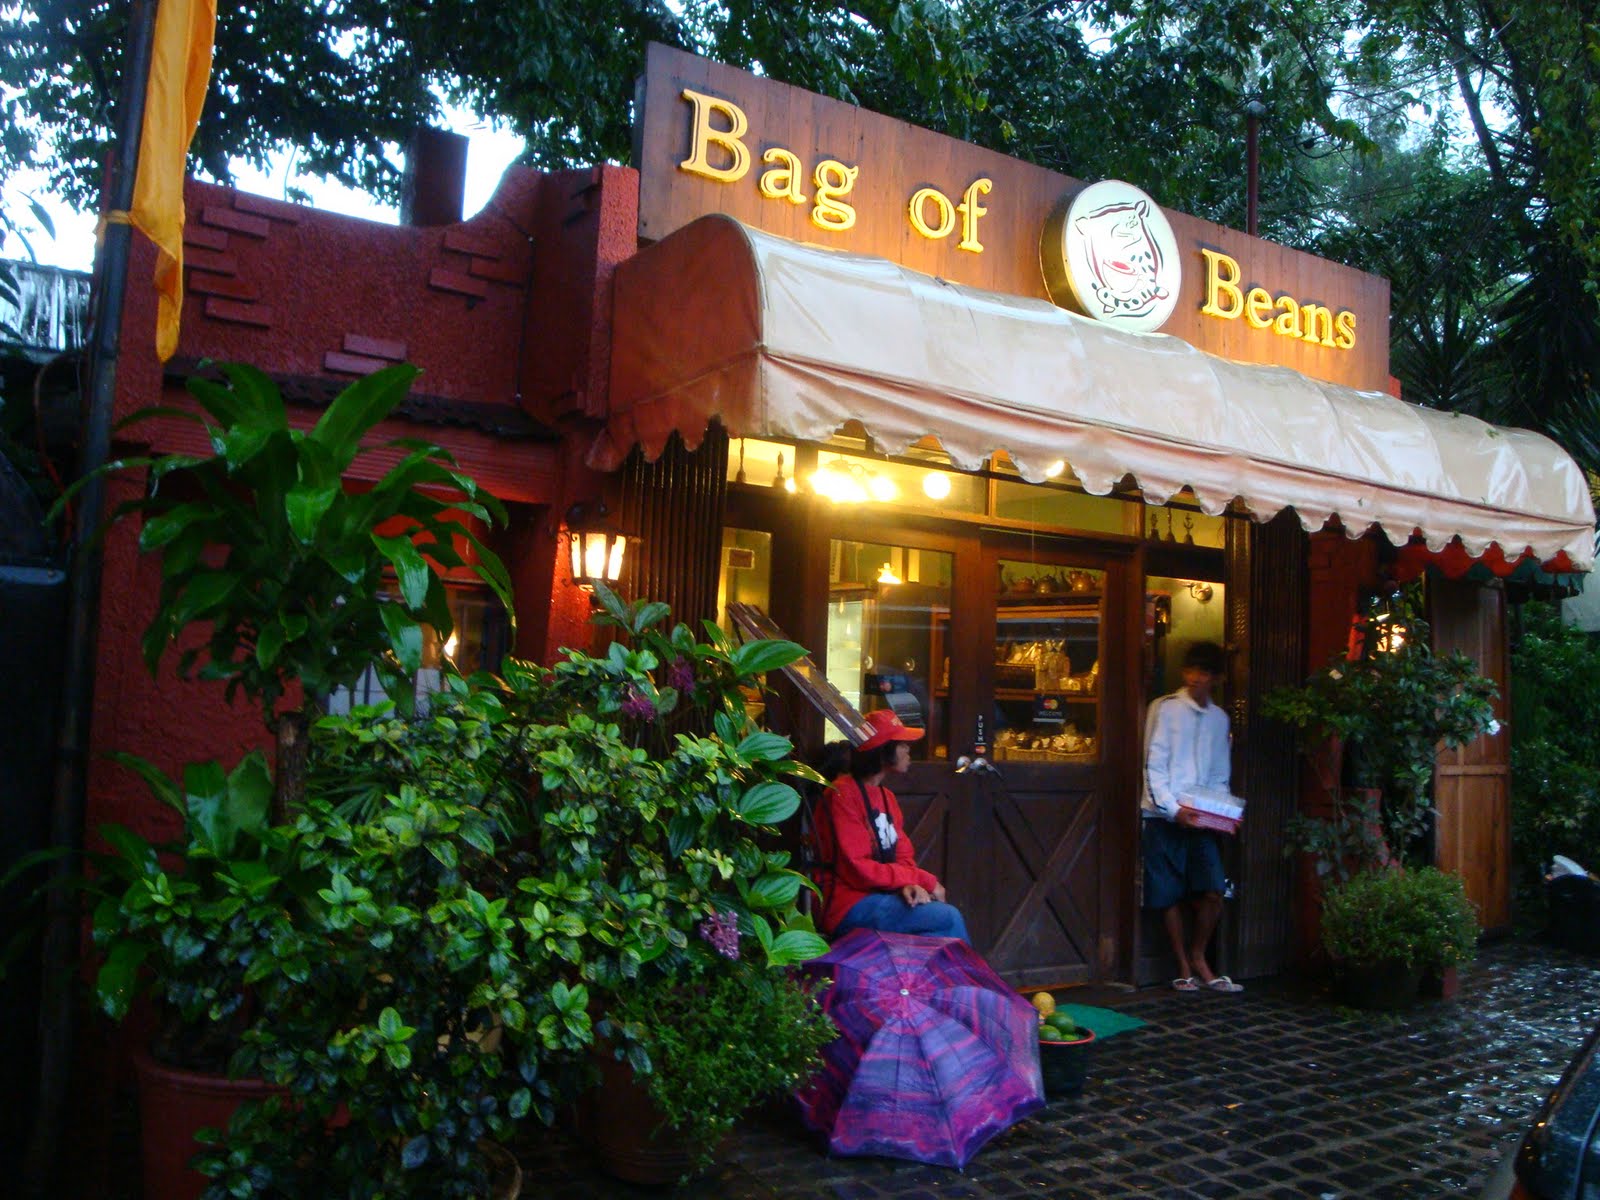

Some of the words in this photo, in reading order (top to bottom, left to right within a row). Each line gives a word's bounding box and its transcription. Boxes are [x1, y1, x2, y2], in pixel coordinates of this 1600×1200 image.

[679, 88, 859, 232] Bag
[908, 177, 993, 254] of
[1201, 247, 1357, 350] Beans
